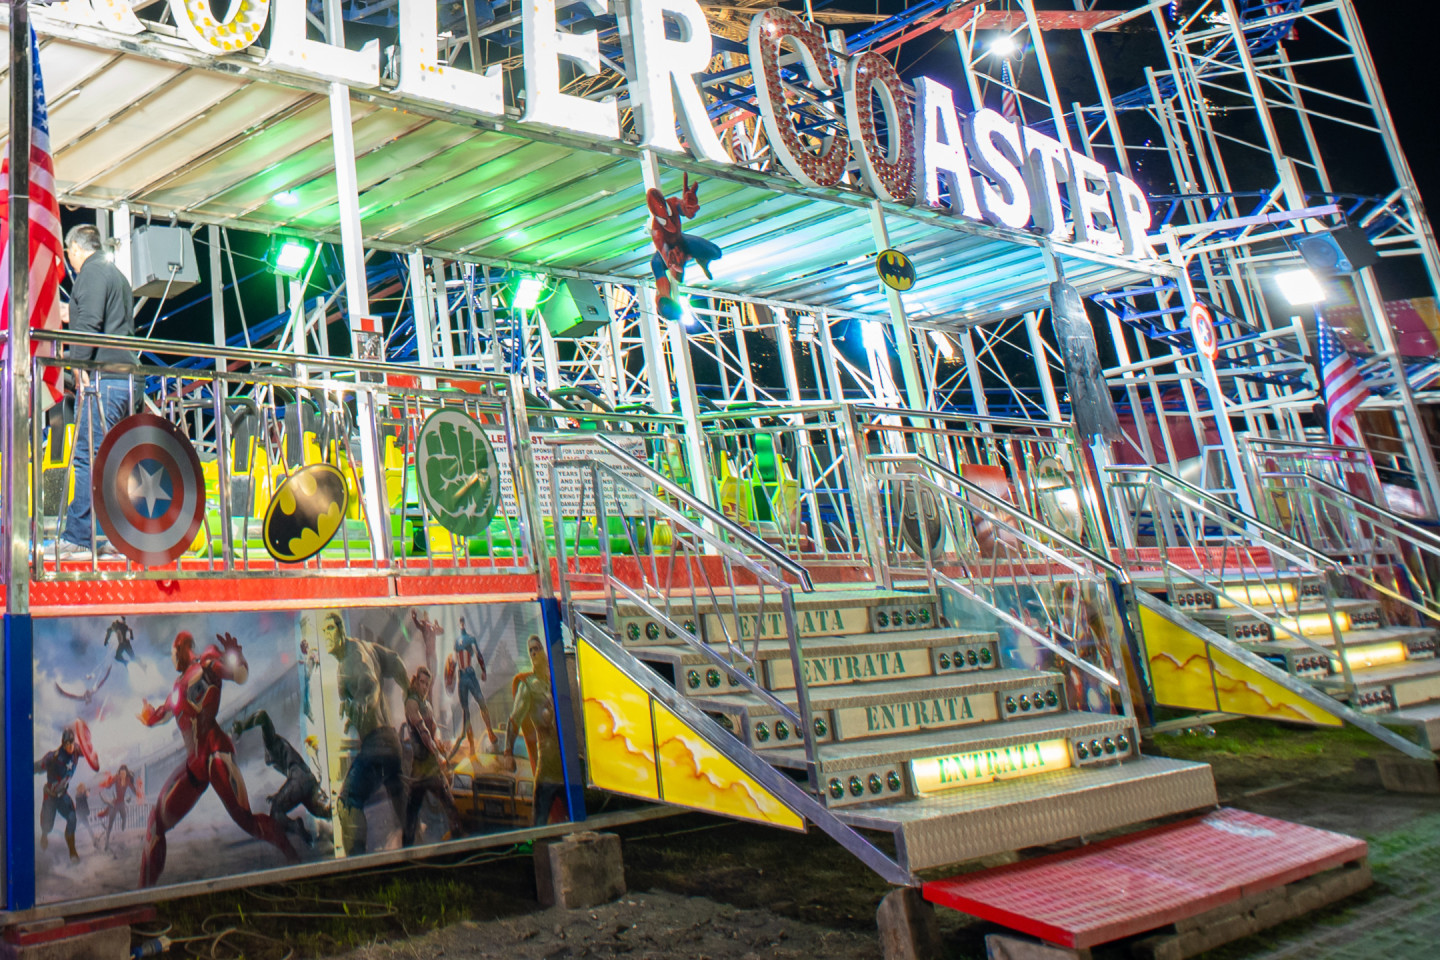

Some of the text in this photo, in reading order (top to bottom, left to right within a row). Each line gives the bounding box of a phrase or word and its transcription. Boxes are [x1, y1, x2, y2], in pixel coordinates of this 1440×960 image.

[748, 6, 1160, 259] COASTER
[739, 609, 845, 637] ENTATA
[803, 652, 906, 683] ENTRATA
[865, 697, 974, 731] ENTRATA
[938, 743, 1046, 784] ENTRATA
